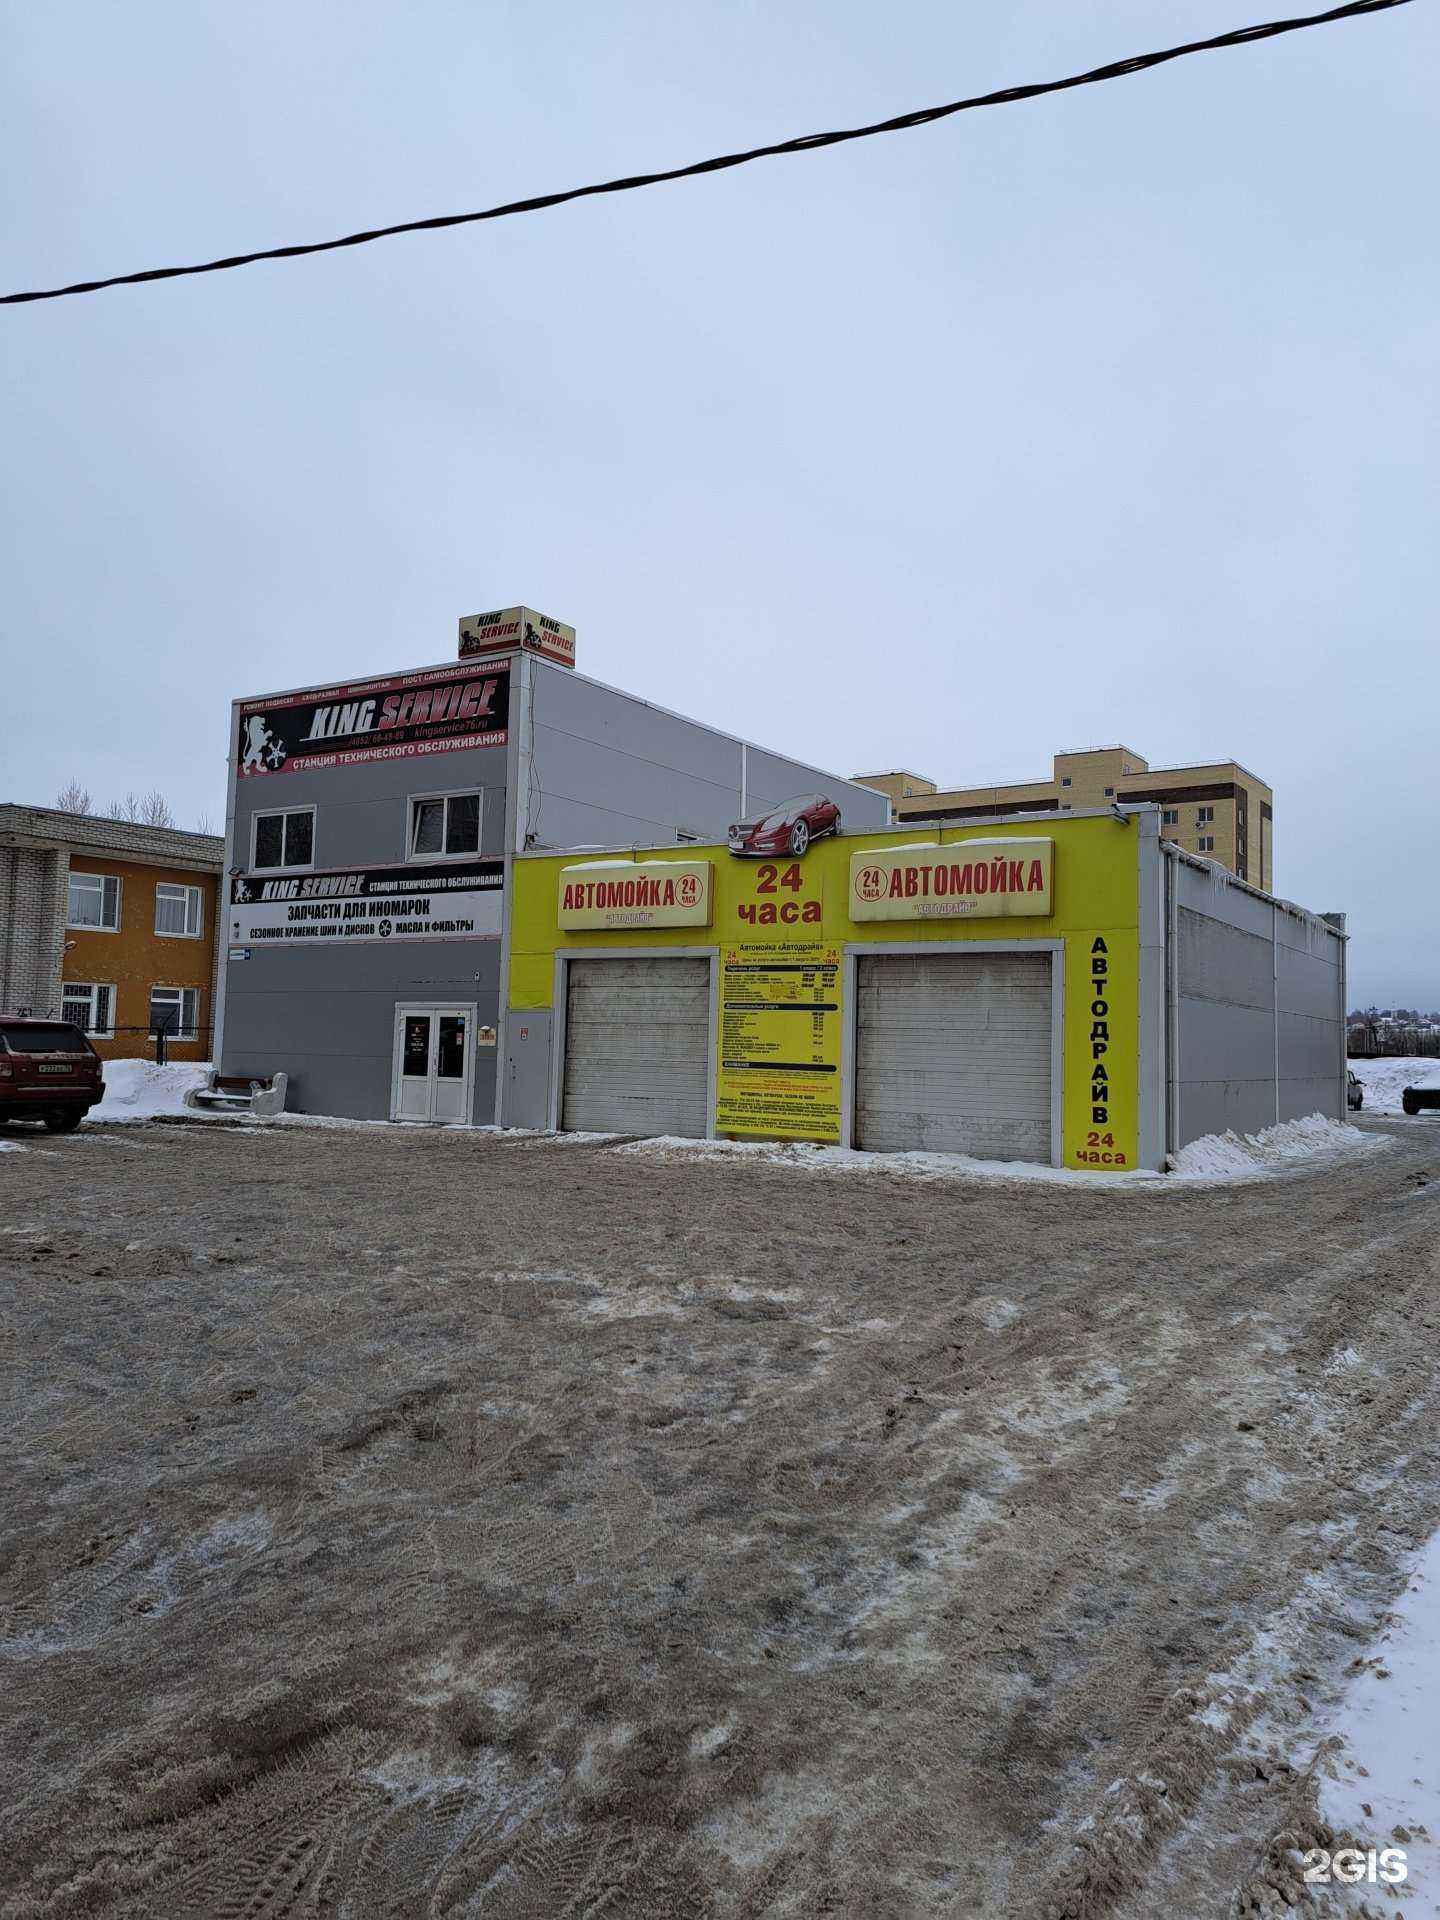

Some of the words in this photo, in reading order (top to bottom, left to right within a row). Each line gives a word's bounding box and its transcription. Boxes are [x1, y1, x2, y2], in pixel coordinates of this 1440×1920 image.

[478, 613, 502, 627] KING
[539, 616, 560, 633] KING
[480, 622, 520, 639] SERVICE
[541, 630, 573, 652] SERVICE
[402, 675, 422, 685] ПОСТ
[424, 660, 509, 680] САМООБСЛУЖИВАНИЯ
[309, 699, 377, 739] KING
[378, 680, 498, 729] SERVICE
[293, 756, 336, 769] СТАНЦИЯ
[339, 745, 415, 763] ТЕХНИЧЕСКОГО
[417, 733, 505, 752] ОБСЛУЖИВАНИЯ
[369, 881, 398, 892] СТАНЦИЯ
[399, 878, 447, 890] ТЕХНИЧЕСКОГО
[447, 874, 503, 887] ОБСЛУЖИВАНИЯ
[682, 878, 696, 894] 24
[757, 863, 803, 894] 24
[863, 870, 879, 888] 24
[889, 856, 1044, 898] АВТОМОЙКА
[261, 880, 299, 899] KING
[300, 875, 366, 897] SERVICE
[563, 876, 675, 910] АВТОМОЙКА
[863, 889, 880, 898] ЧАСА
[682, 895, 696, 904] ЧАСА
[287, 903, 341, 921] ЗАПЧАСТИ
[343, 902, 366, 920] ДЛЯ
[368, 899, 431, 917] ИНОМАРОК
[738, 901, 822, 924] часа
[249, 927, 284, 939] СЕЗОННОЕ
[284, 926, 319, 937] ХРАНЕНИЕ
[319, 925, 337, 936] ШИН
[338, 925, 343, 935] И
[344, 923, 375, 936] ДИСКОВ
[396, 922, 423, 934] МАСЛА
[424, 922, 430, 932] И
[431, 919, 474, 932] ФИЛЬТРЫ
[739, 943, 776, 951] Автомойка
[826, 949, 837, 957] 24
[1090, 937, 1109, 1124] АВТОДРАЙВ
[1087, 1132, 1114, 1148] 24
[1076, 1150, 1126, 1165] часа
